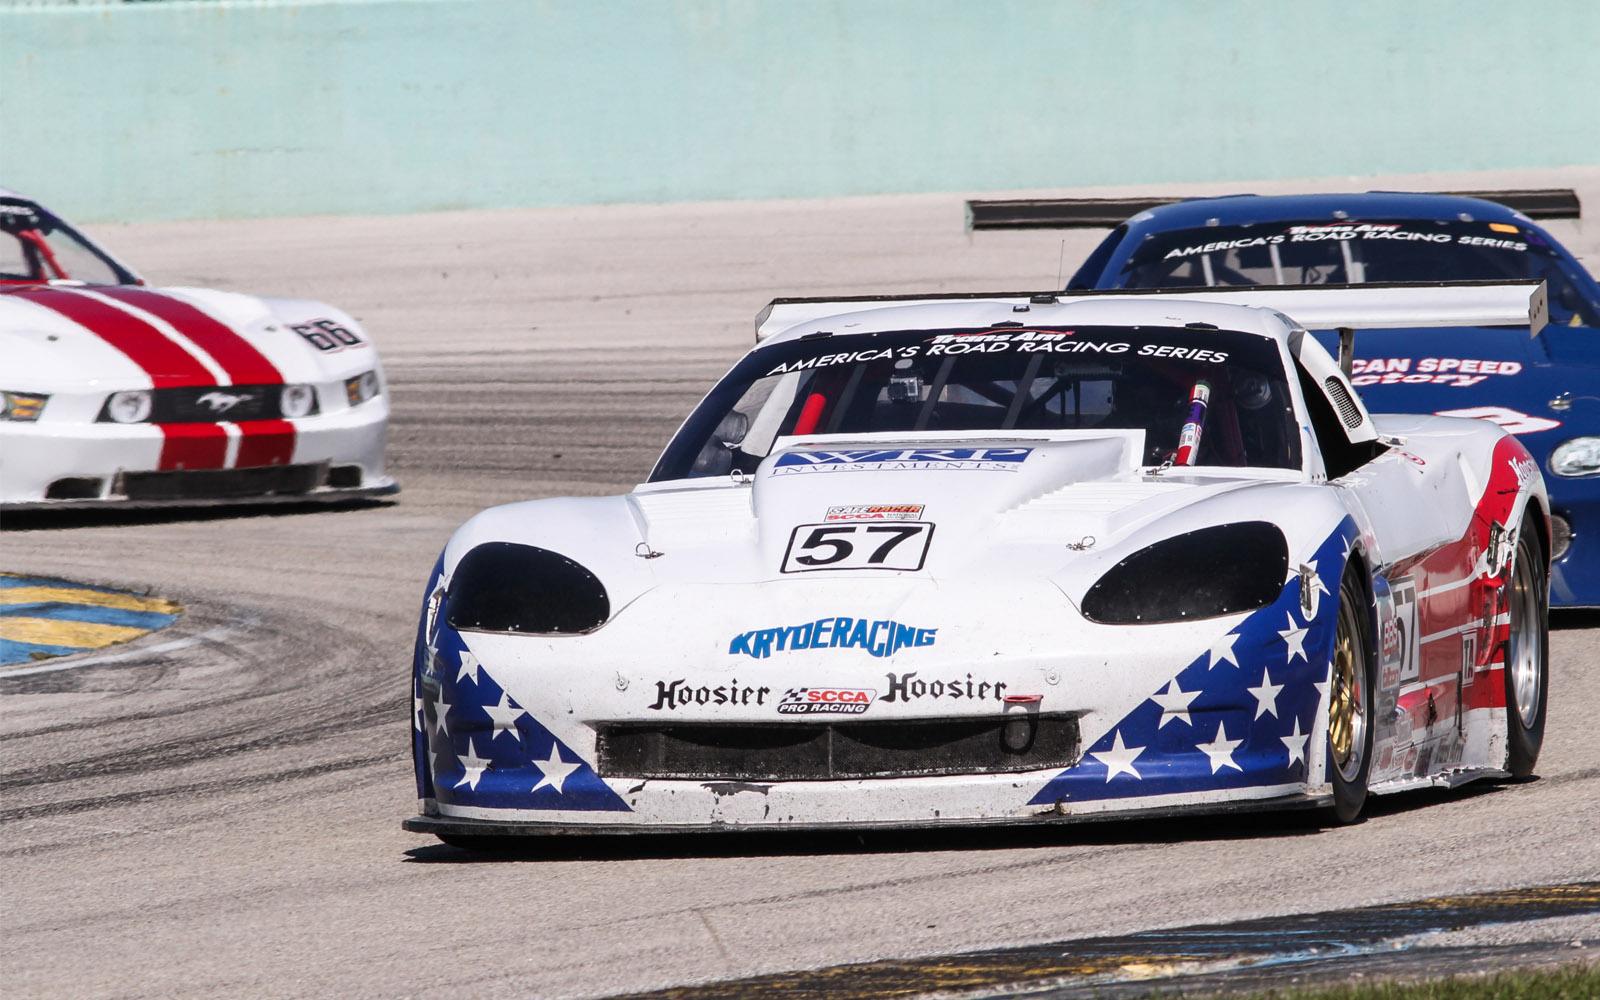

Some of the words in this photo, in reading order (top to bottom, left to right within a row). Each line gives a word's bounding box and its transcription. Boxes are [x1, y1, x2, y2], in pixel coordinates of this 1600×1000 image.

[1163, 234, 1286, 260] AMERICA'S
[1291, 231, 1358, 243] ROAD
[1363, 231, 1453, 243] RACING
[1457, 235, 1529, 252] SERIES
[287, 318, 364, 352] 66
[931, 333, 1010, 344] Trans
[1010, 331, 1068, 342] Am
[765, 345, 921, 377] AMERICA'S
[925, 341, 1010, 356] ROAD
[1016, 340, 1131, 354] RACING
[1137, 344, 1230, 364] SERIES
[1416, 357, 1523, 376] SPEED
[772, 461, 1013, 476] INVESTMENTS
[786, 448, 1029, 464] WRP
[795, 525, 923, 567] 57
[727, 617, 939, 659] KRYDERACING
[647, 678, 771, 711] Hoosier
[807, 690, 870, 703] SCCA
[878, 671, 1008, 704] Hoosier
[779, 703, 808, 713] PRO
[810, 703, 866, 713] RACING
